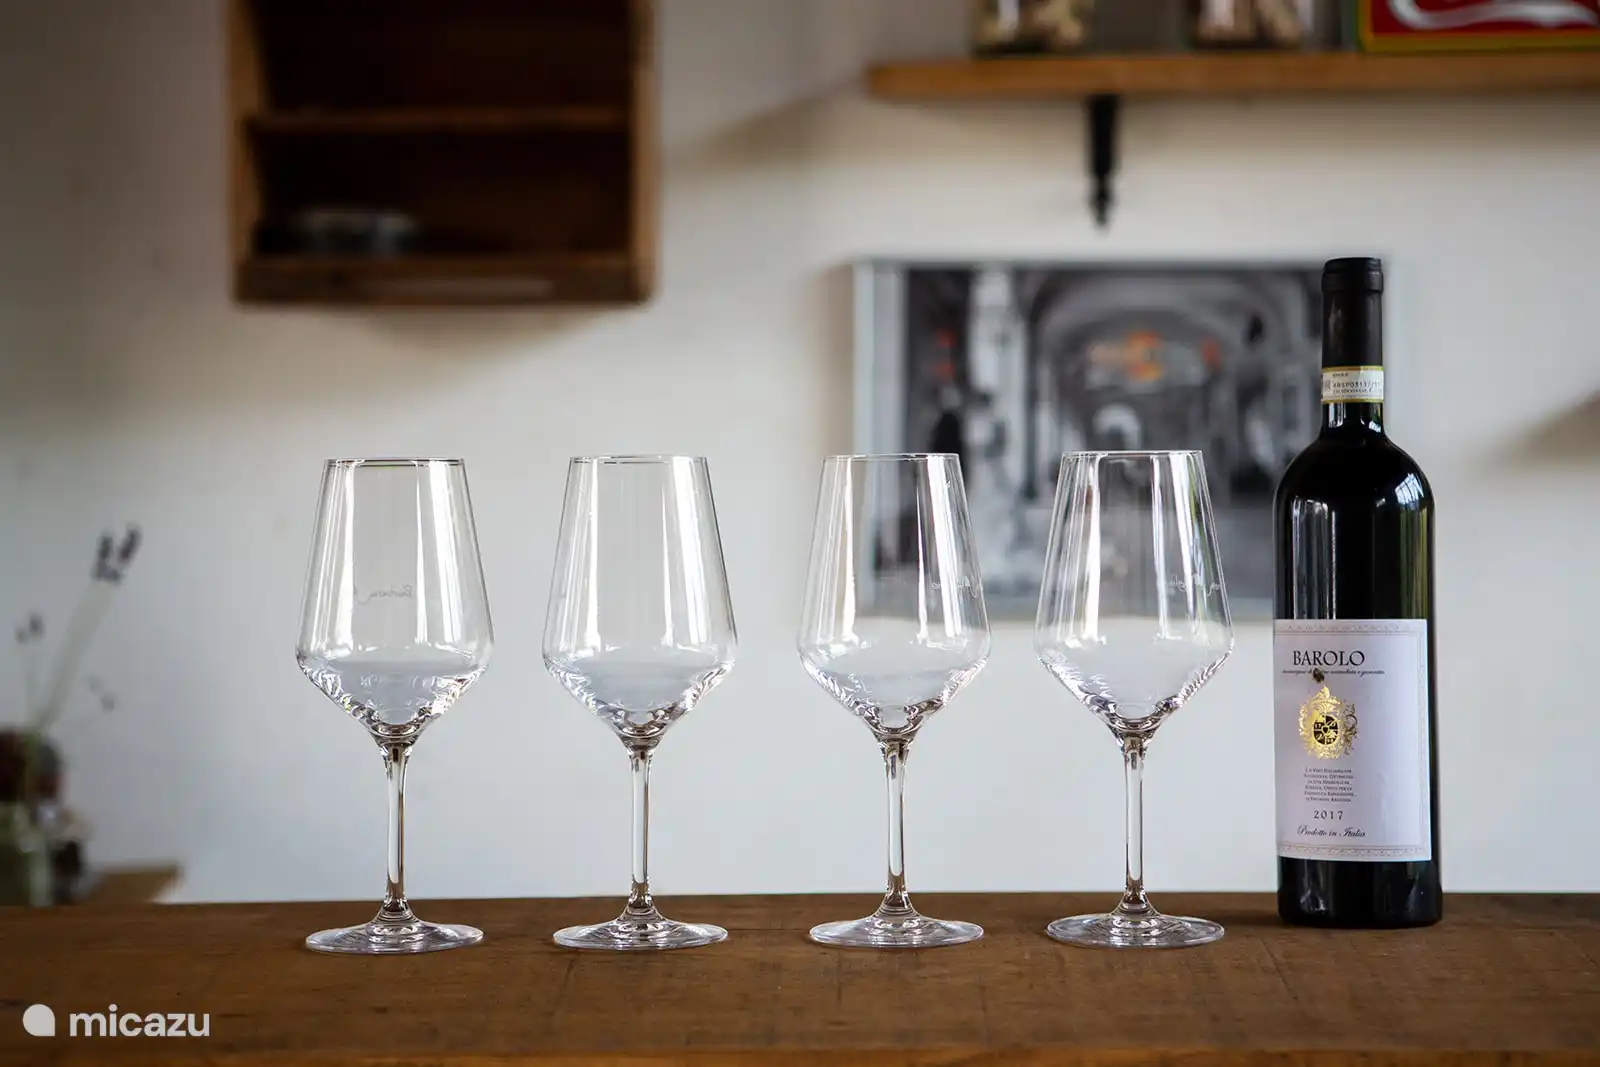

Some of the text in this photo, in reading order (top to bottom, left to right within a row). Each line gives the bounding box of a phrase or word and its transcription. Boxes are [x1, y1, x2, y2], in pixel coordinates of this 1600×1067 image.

[1292, 650, 1365, 667] BAROLO
[1313, 810, 1343, 820] 2017
[1296, 824, 1327, 837] Prodotto
[1339, 826, 1366, 838] Italia
